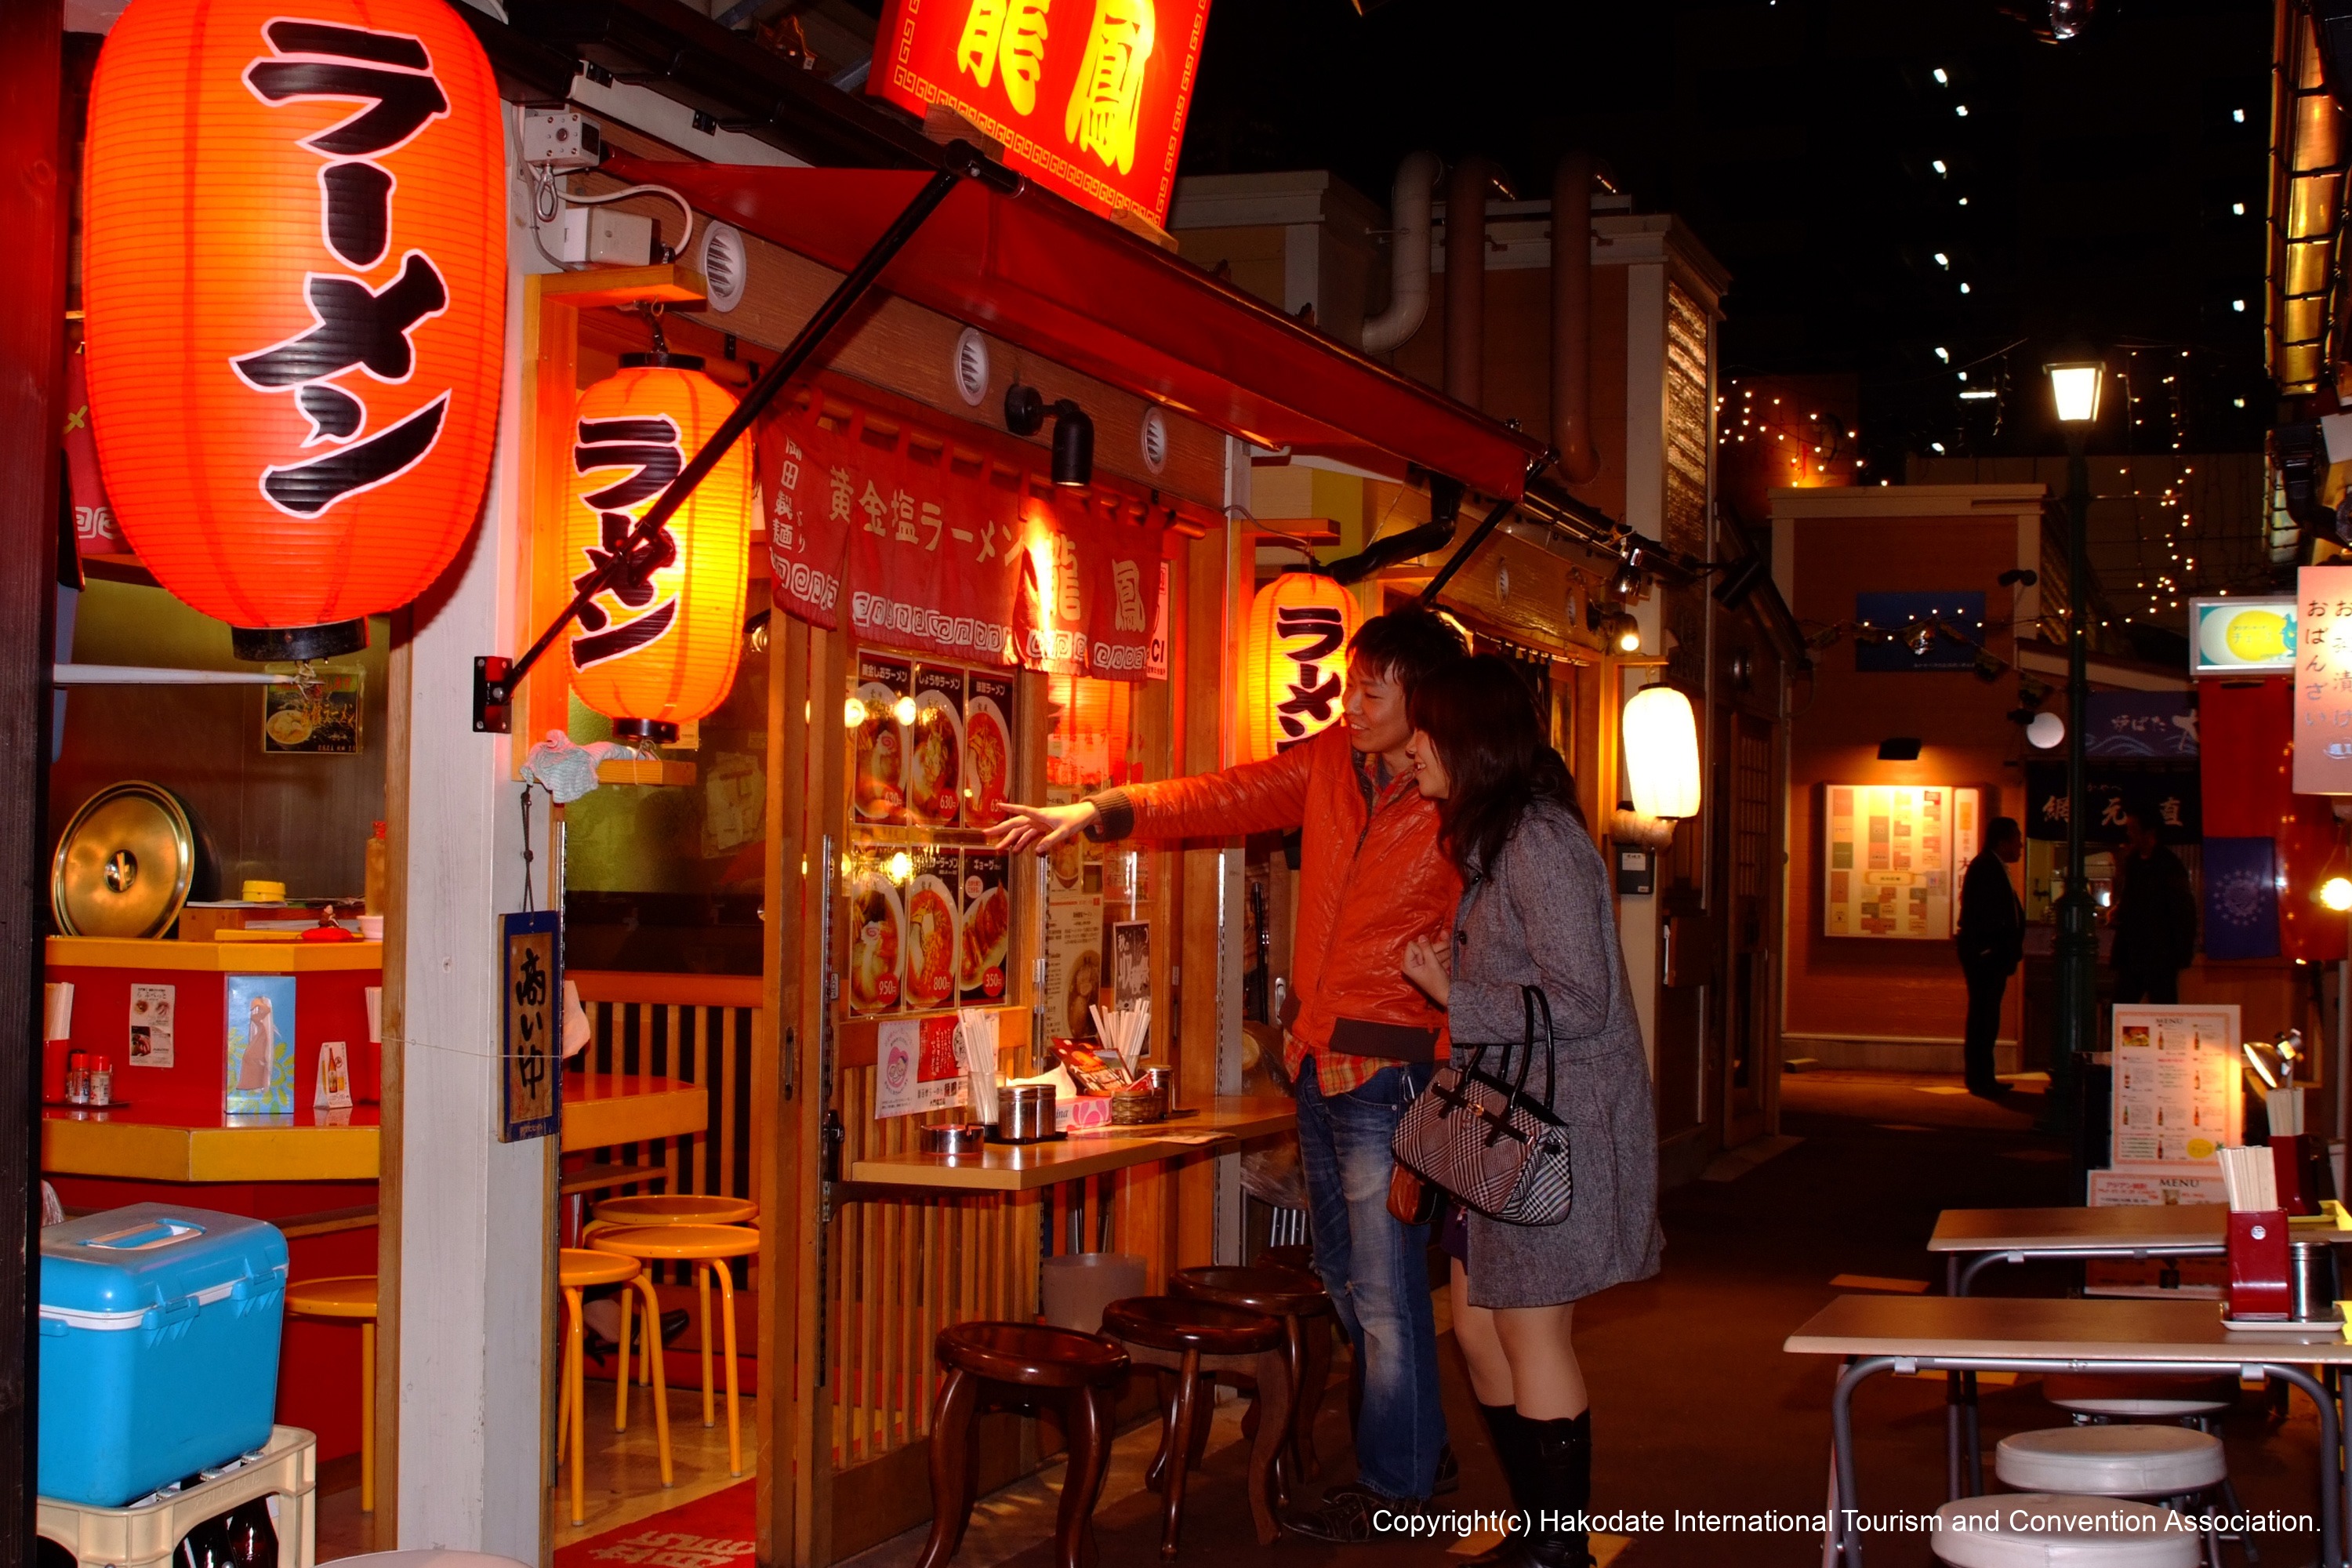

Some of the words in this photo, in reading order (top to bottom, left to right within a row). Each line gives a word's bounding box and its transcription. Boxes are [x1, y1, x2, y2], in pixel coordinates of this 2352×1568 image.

[230, 17, 452, 518] ラーメン
[571, 413, 687, 673] ラーメン
[829, 465, 1022, 566] 黄金塩ラーメン
[1275, 604, 1346, 756] ラーメン
[2305, 600, 2328, 727] おばんざい
[515, 947, 546, 1101] 商い中
[878, 980, 897, 996] 950円
[933, 976, 951, 991] 800円
[985, 973, 1002, 987] 350円
[2160, 1178, 2200, 1188] MENU
